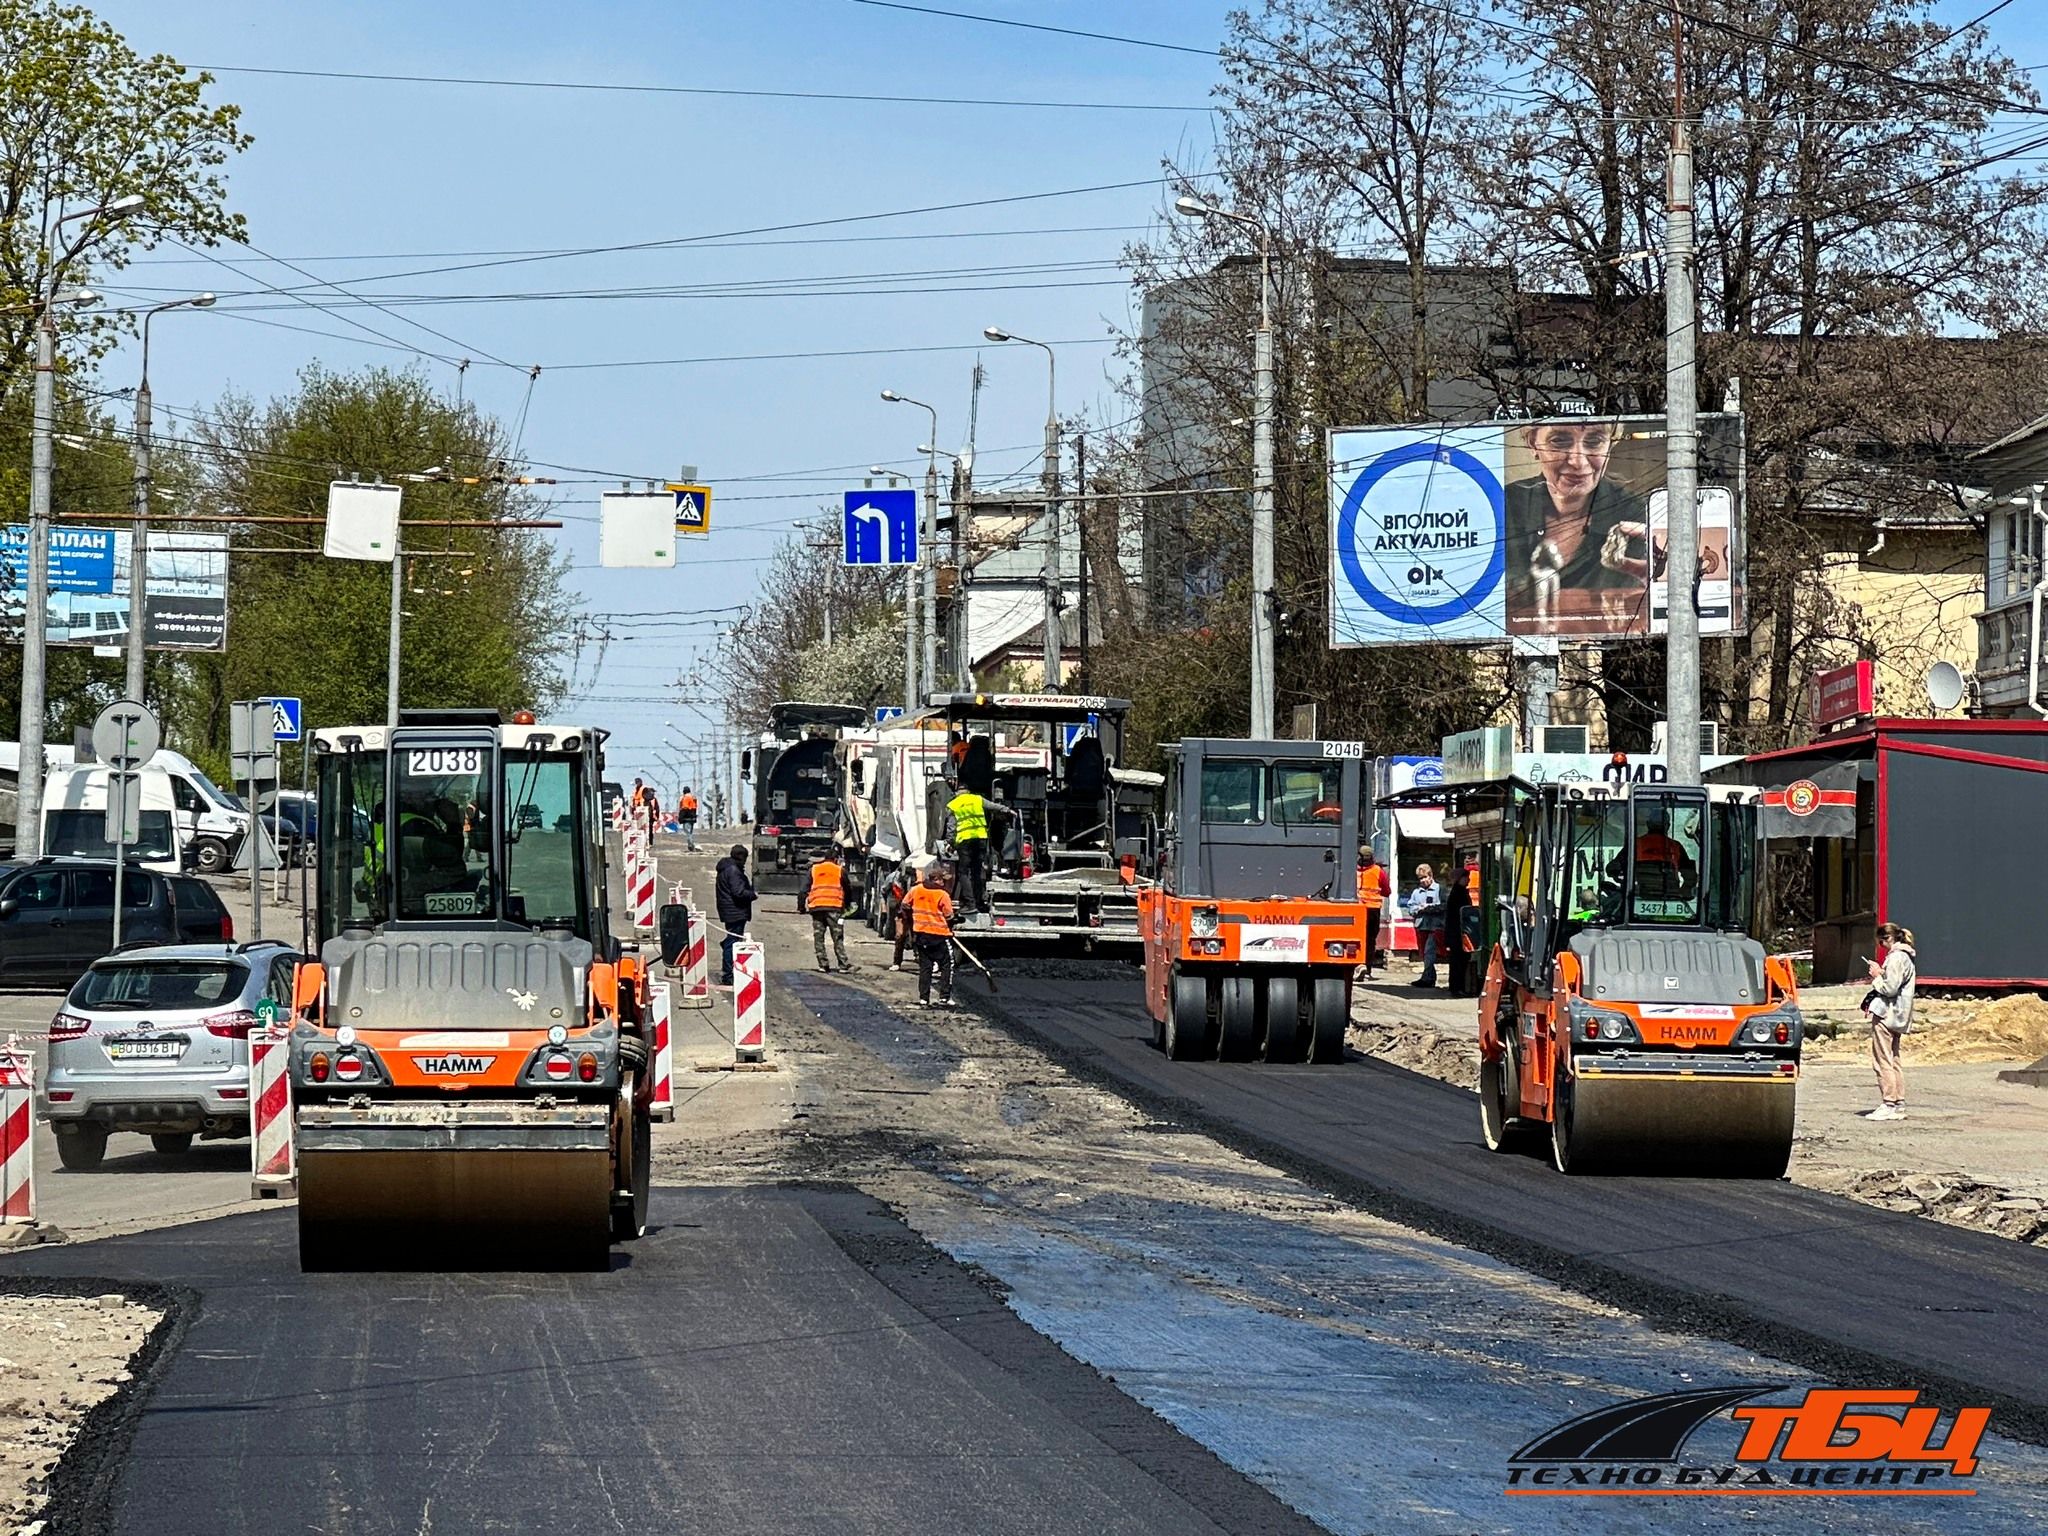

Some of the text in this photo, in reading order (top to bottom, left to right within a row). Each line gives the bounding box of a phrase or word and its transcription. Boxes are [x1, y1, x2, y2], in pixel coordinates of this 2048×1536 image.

[1383, 508, 1469, 530] ВПОЛЮЙ
[1374, 531, 1478, 551] АКТУАЛЬНЕ
[1407, 565, 1443, 586] olx
[1079, 697, 1106, 710] 2065
[1326, 743, 1360, 756] 2046
[413, 749, 477, 772] 2038
[429, 897, 473, 912] 25809
[1254, 914, 1295, 924] HAMM
[1660, 1026, 1717, 1040] HAMM
[136, 1043, 159, 1053] 0316
[425, 1059, 483, 1072] HAMM
